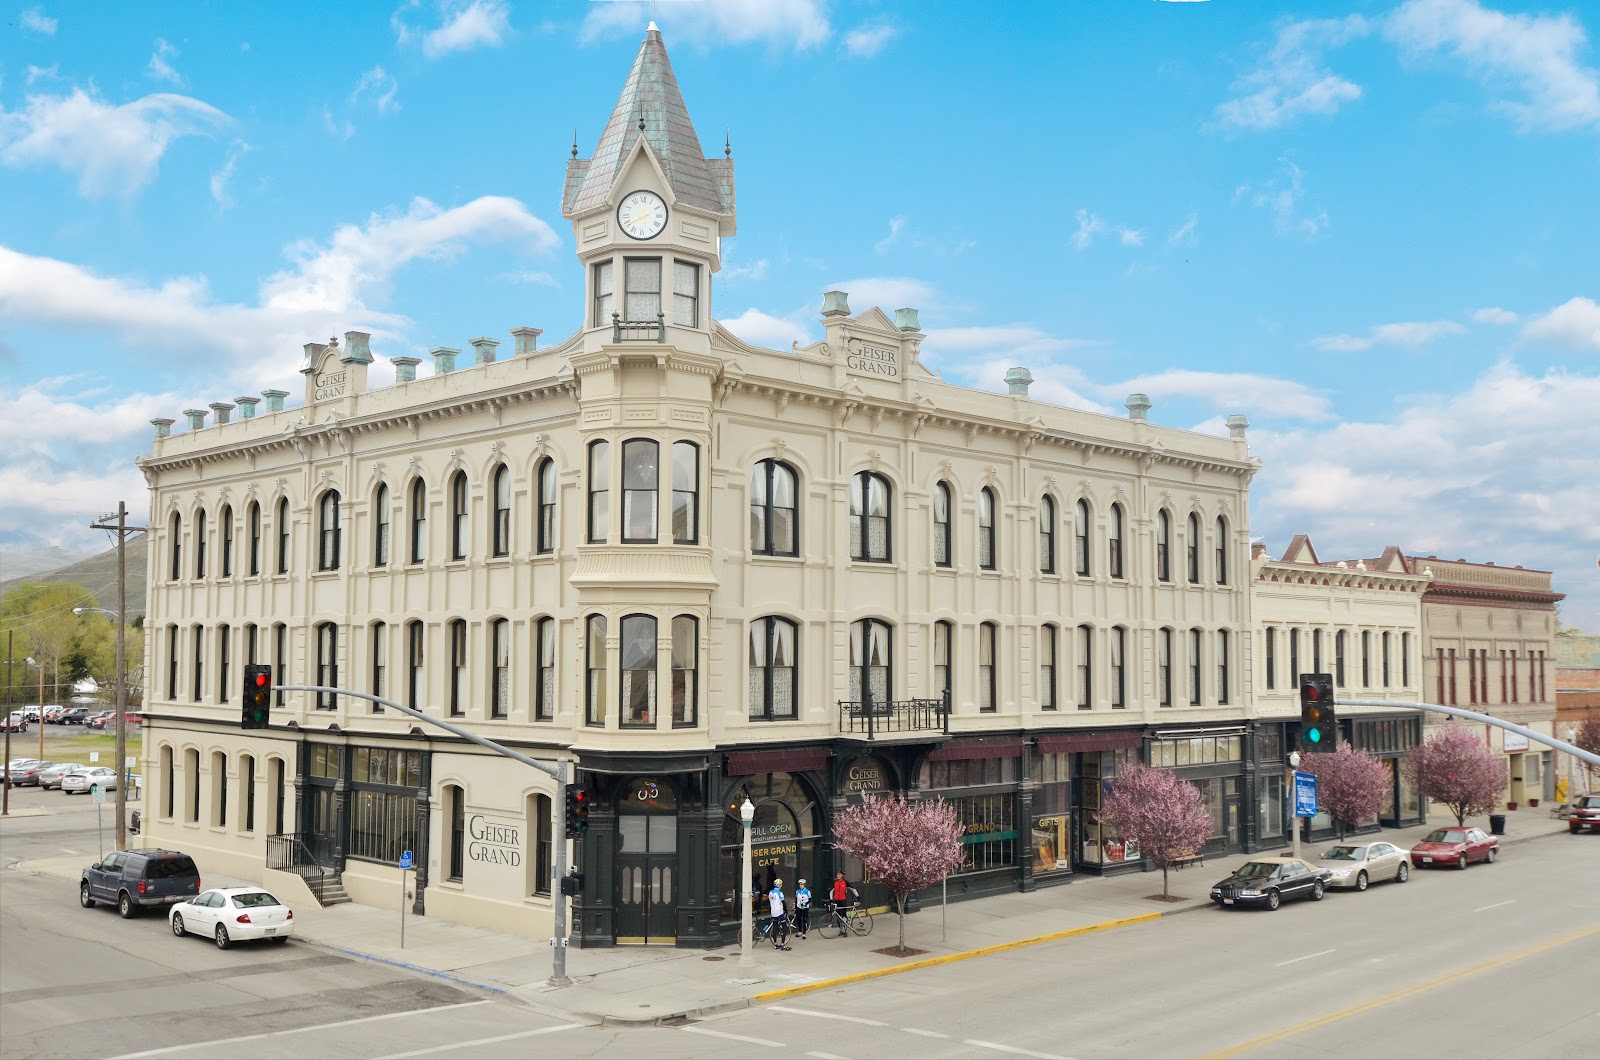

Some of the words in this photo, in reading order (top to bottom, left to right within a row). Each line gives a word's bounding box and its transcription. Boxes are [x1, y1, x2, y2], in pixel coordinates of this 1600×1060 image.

[848, 338, 896, 363] GEISER
[847, 355, 897, 376] GRAND
[315, 386, 345, 400] GRAN
[849, 767, 879, 780] GEISER
[849, 781, 880, 790] GRAND
[968, 822, 995, 833] GRAND
[1039, 817, 1059, 827] GIFTS
[469, 815, 520, 845] GEISER
[752, 827, 767, 836] RILL
[770, 824, 792, 834] OPEN
[469, 842, 521, 867] GRAND
[770, 845, 797, 855] GRAND
[758, 857, 780, 867] CAFE
